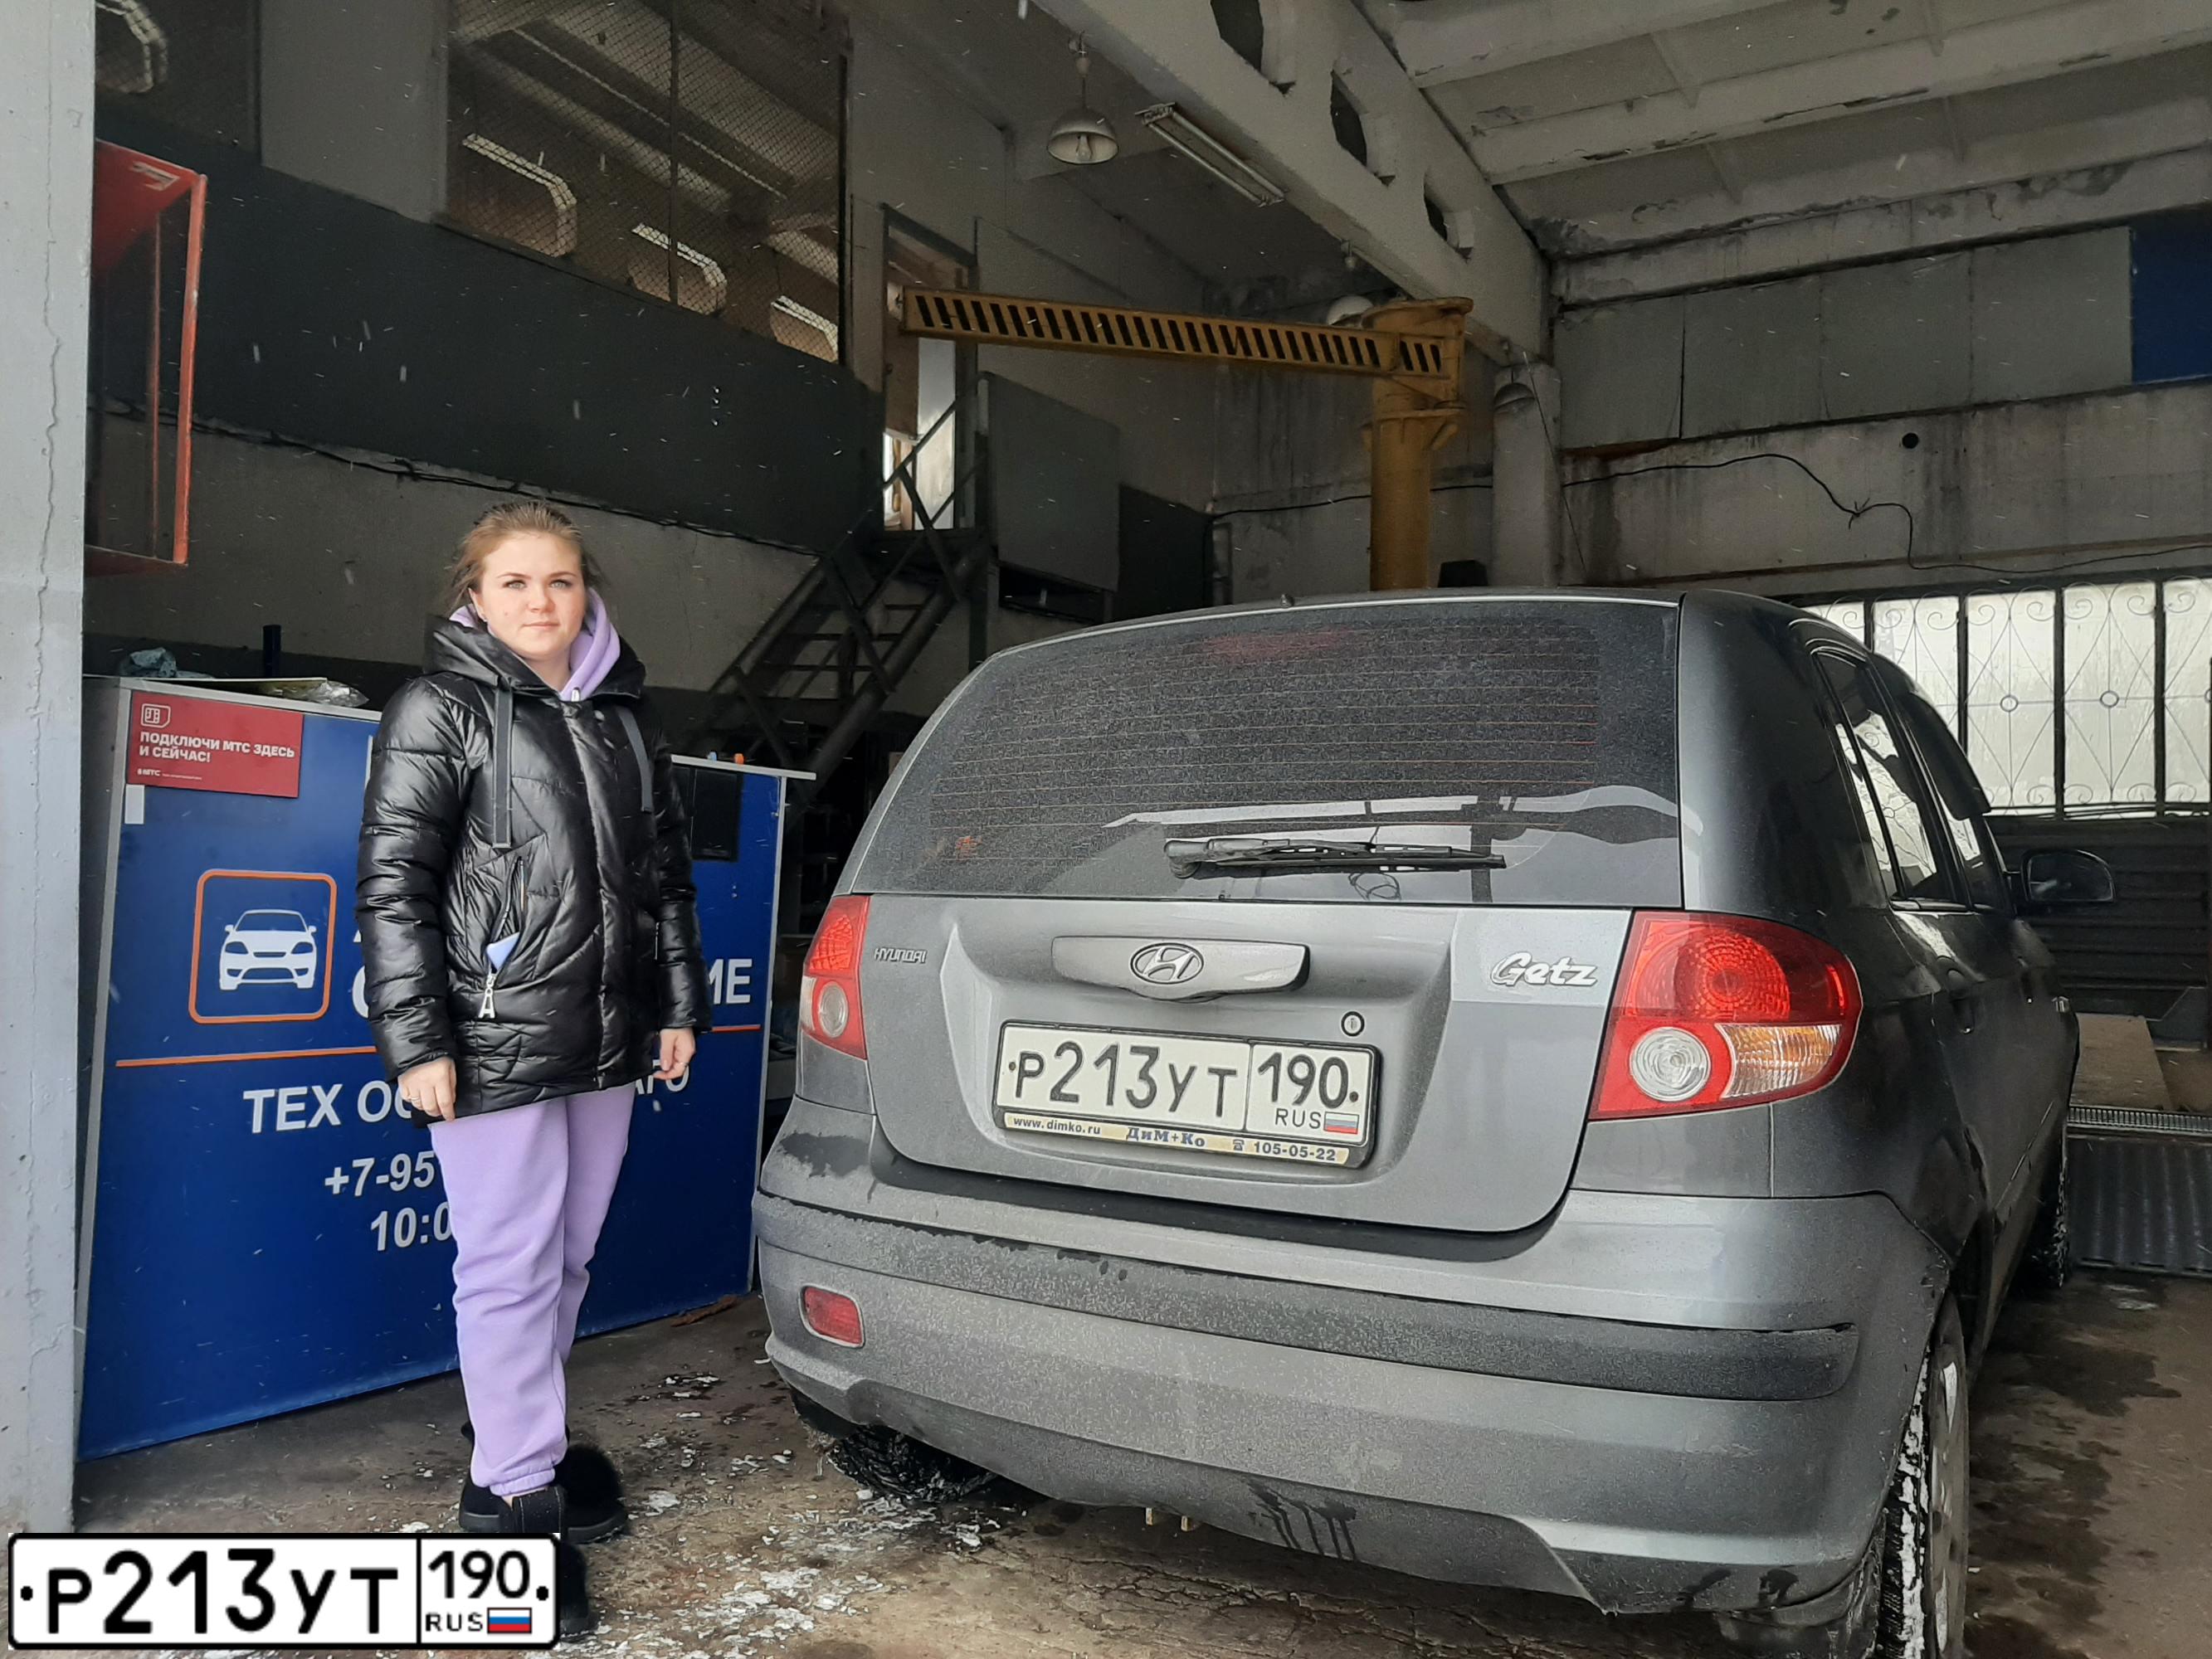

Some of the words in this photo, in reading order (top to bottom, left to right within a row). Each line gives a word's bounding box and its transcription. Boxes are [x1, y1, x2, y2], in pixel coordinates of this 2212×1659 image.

[139, 746, 149, 757] И
[153, 747, 211, 762] СЕЙЧАС!
[140, 732, 219, 749] ПОДКЛЮЧИ
[222, 741, 251, 753] МТС
[253, 744, 295, 757] ЗДЕСЬ
[874, 946, 928, 964] HYUNDAI
[1491, 951, 1599, 986] Getz
[1258, 1052, 1349, 1109] 190
[243, 1083, 343, 1134] ТЕХ
[1274, 1107, 1322, 1130] RUS
[1013, 1117, 1102, 1135] www.dimko.ru
[1254, 1141, 1336, 1161] 105-05-22
